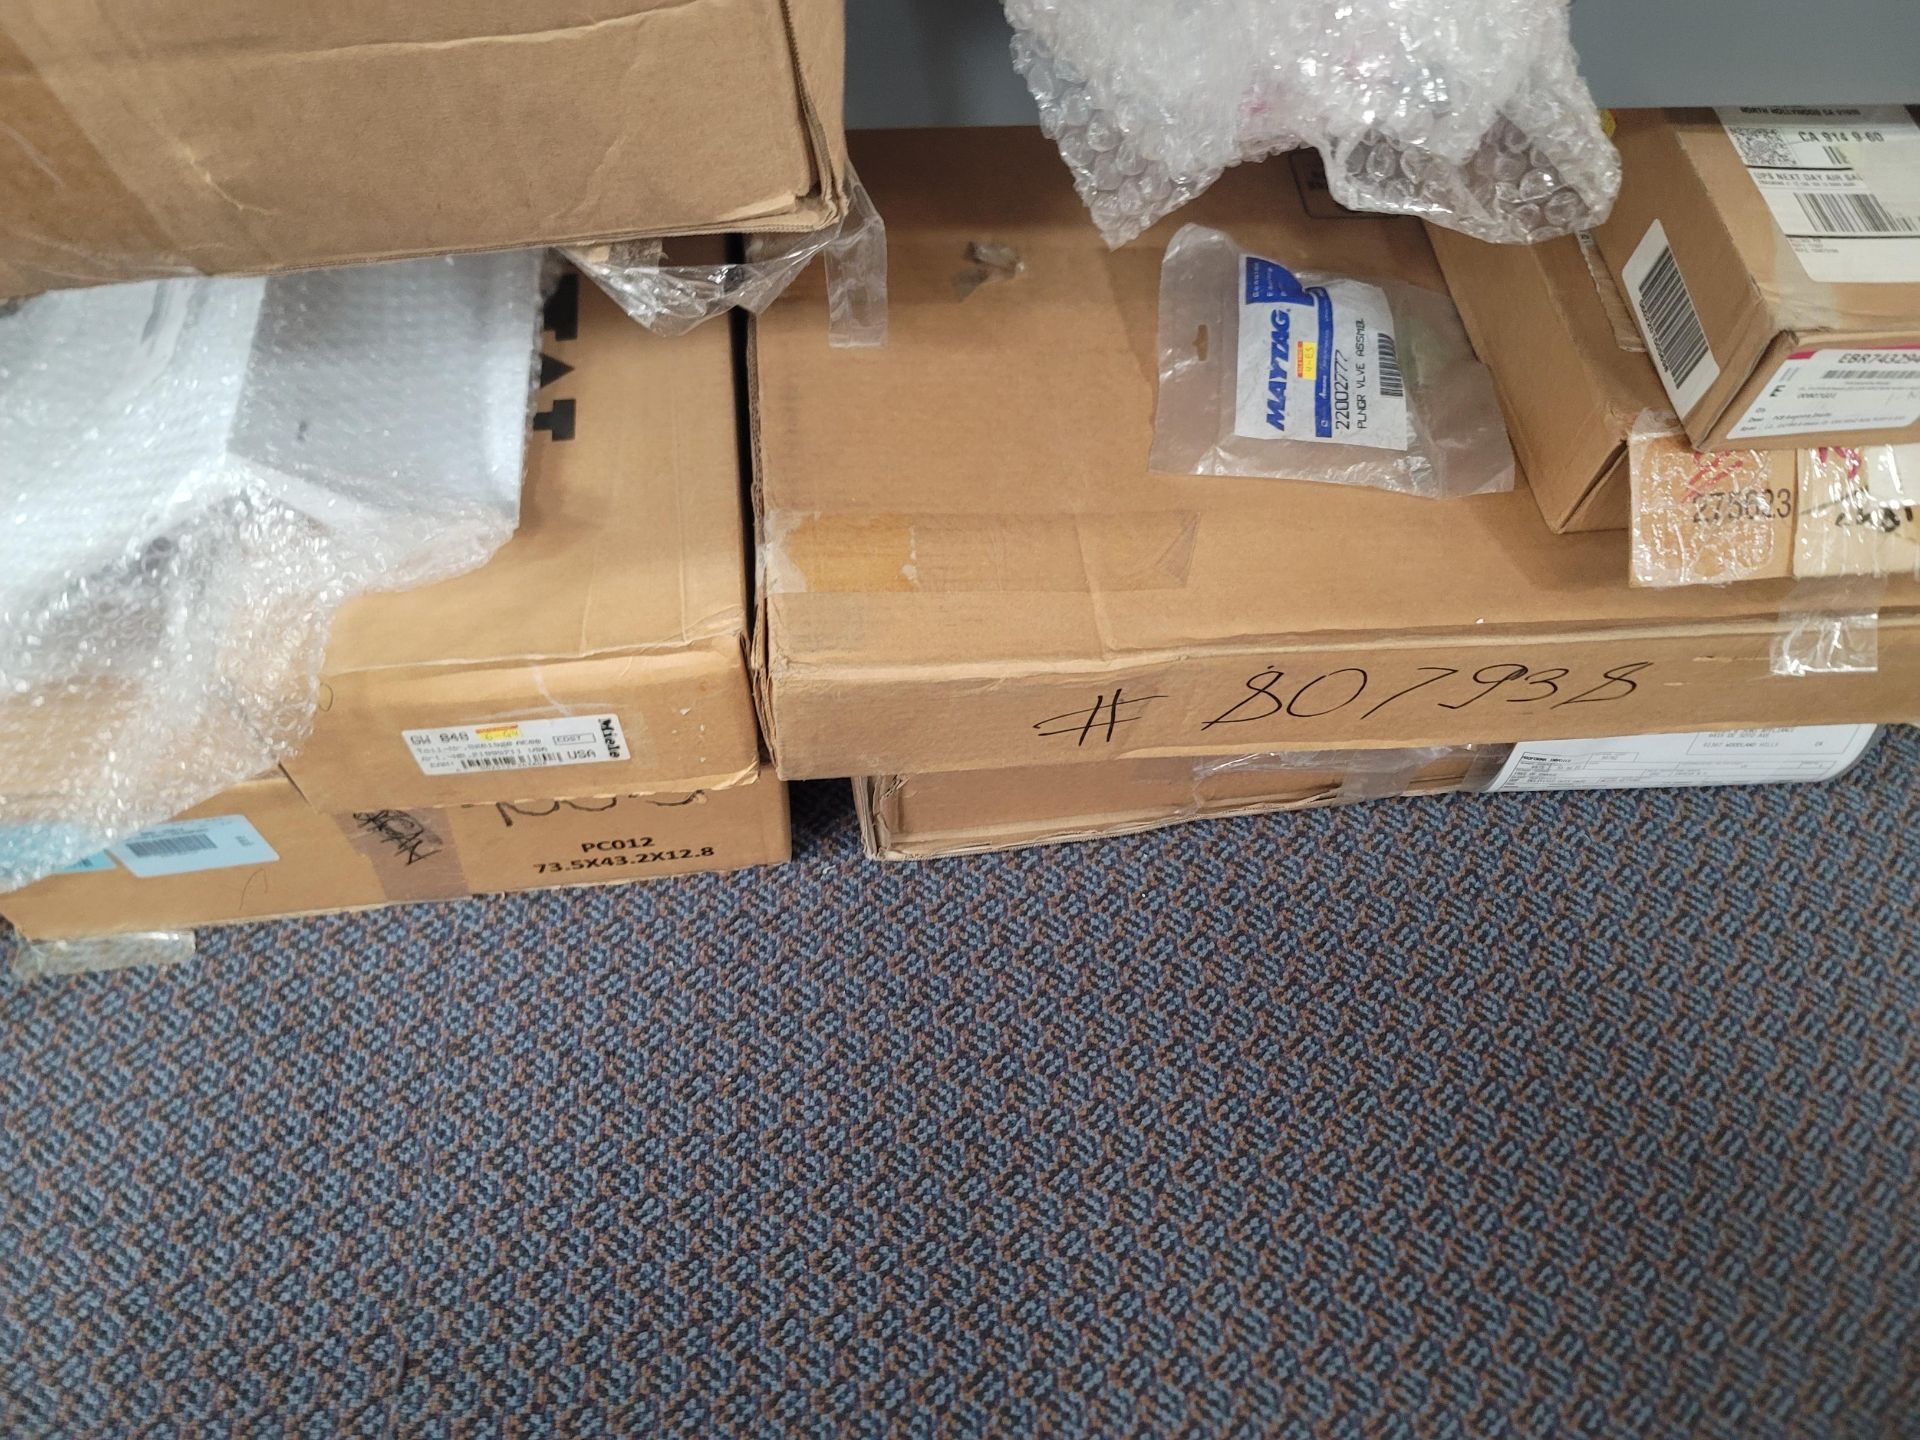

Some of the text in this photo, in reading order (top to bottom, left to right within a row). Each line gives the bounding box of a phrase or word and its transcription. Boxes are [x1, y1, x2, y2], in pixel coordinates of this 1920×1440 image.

[1798, 131, 1820, 142] CA
[1821, 131, 1848, 142] 914
[1754, 171, 1774, 180] UPS
[1775, 172, 1800, 181] NEXT
[1803, 172, 1823, 181] DAY
[1826, 173, 1842, 181] AIR
[1266, 309, 1290, 432] MAYTAG
[1356, 362, 1366, 389] VLVE
[1334, 349, 1350, 430] 22002777
[1356, 394, 1368, 429] PLNGR
[599, 717, 621, 759] Miele
[566, 749, 597, 760] USA
[581, 836, 656, 852] PC012
[533, 846, 715, 874] 73.5X43.2X12.8
